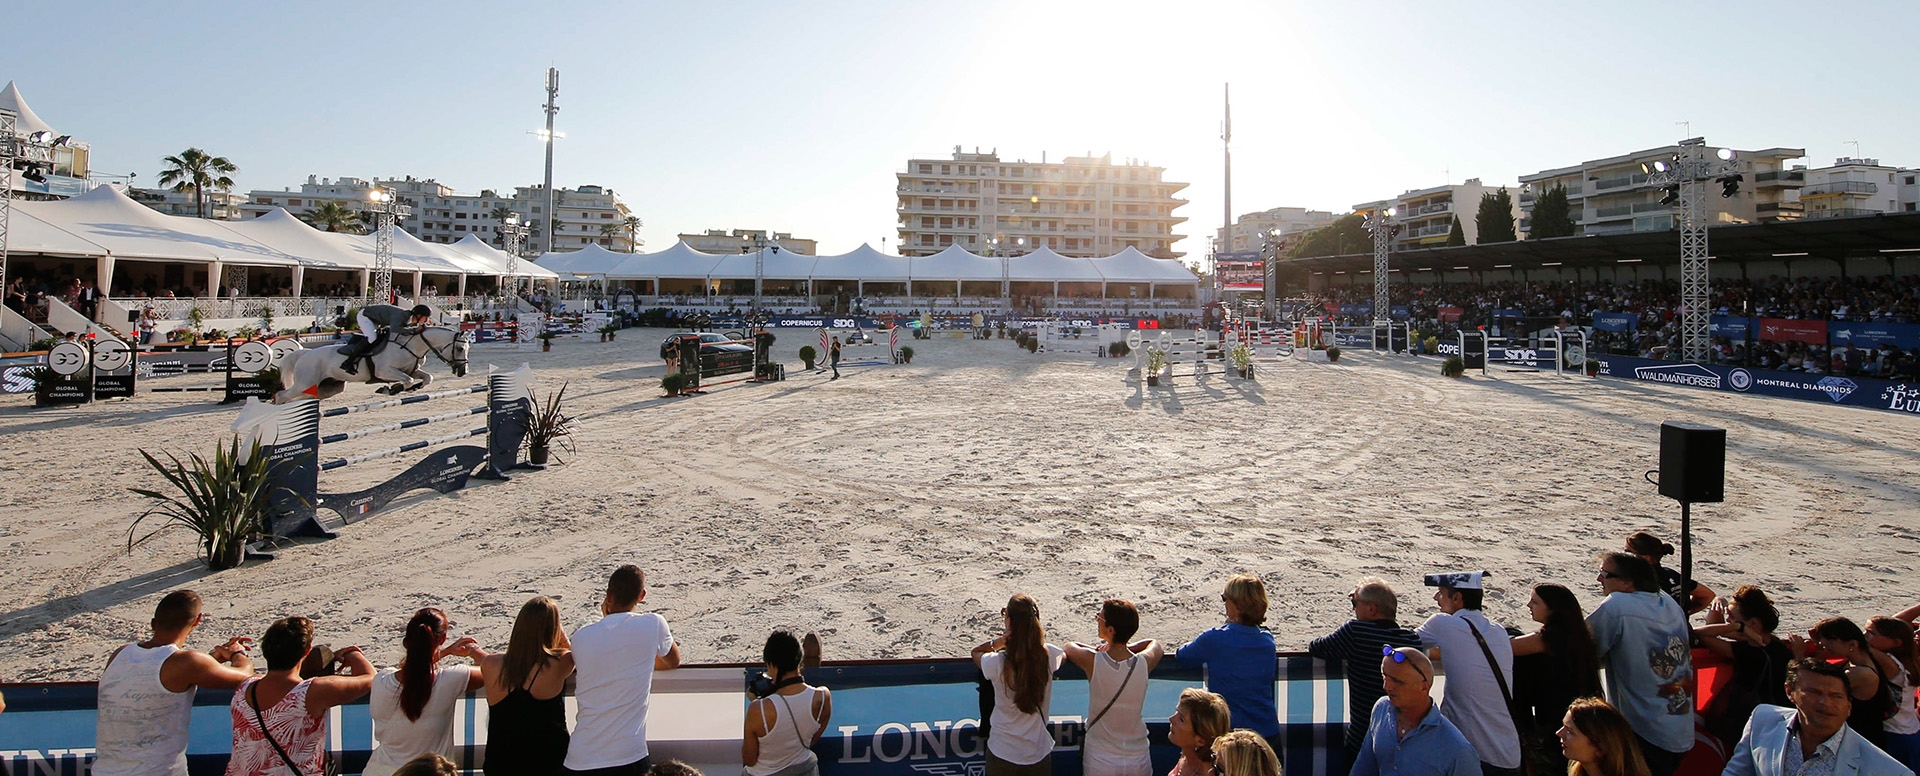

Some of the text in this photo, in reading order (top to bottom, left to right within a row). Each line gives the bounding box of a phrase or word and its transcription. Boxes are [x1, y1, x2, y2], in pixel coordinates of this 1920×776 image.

[781, 319, 823, 327] COPERNICUS
[833, 319, 855, 328] SDG
[1504, 349, 1538, 366] SDG
[1756, 378, 1852, 394] MONTREAL DIAMONDS
[274, 443, 303, 455] LONGINES
[284, 447, 312, 457] CHAMPIONS
[350, 495, 374, 507] Cannes
